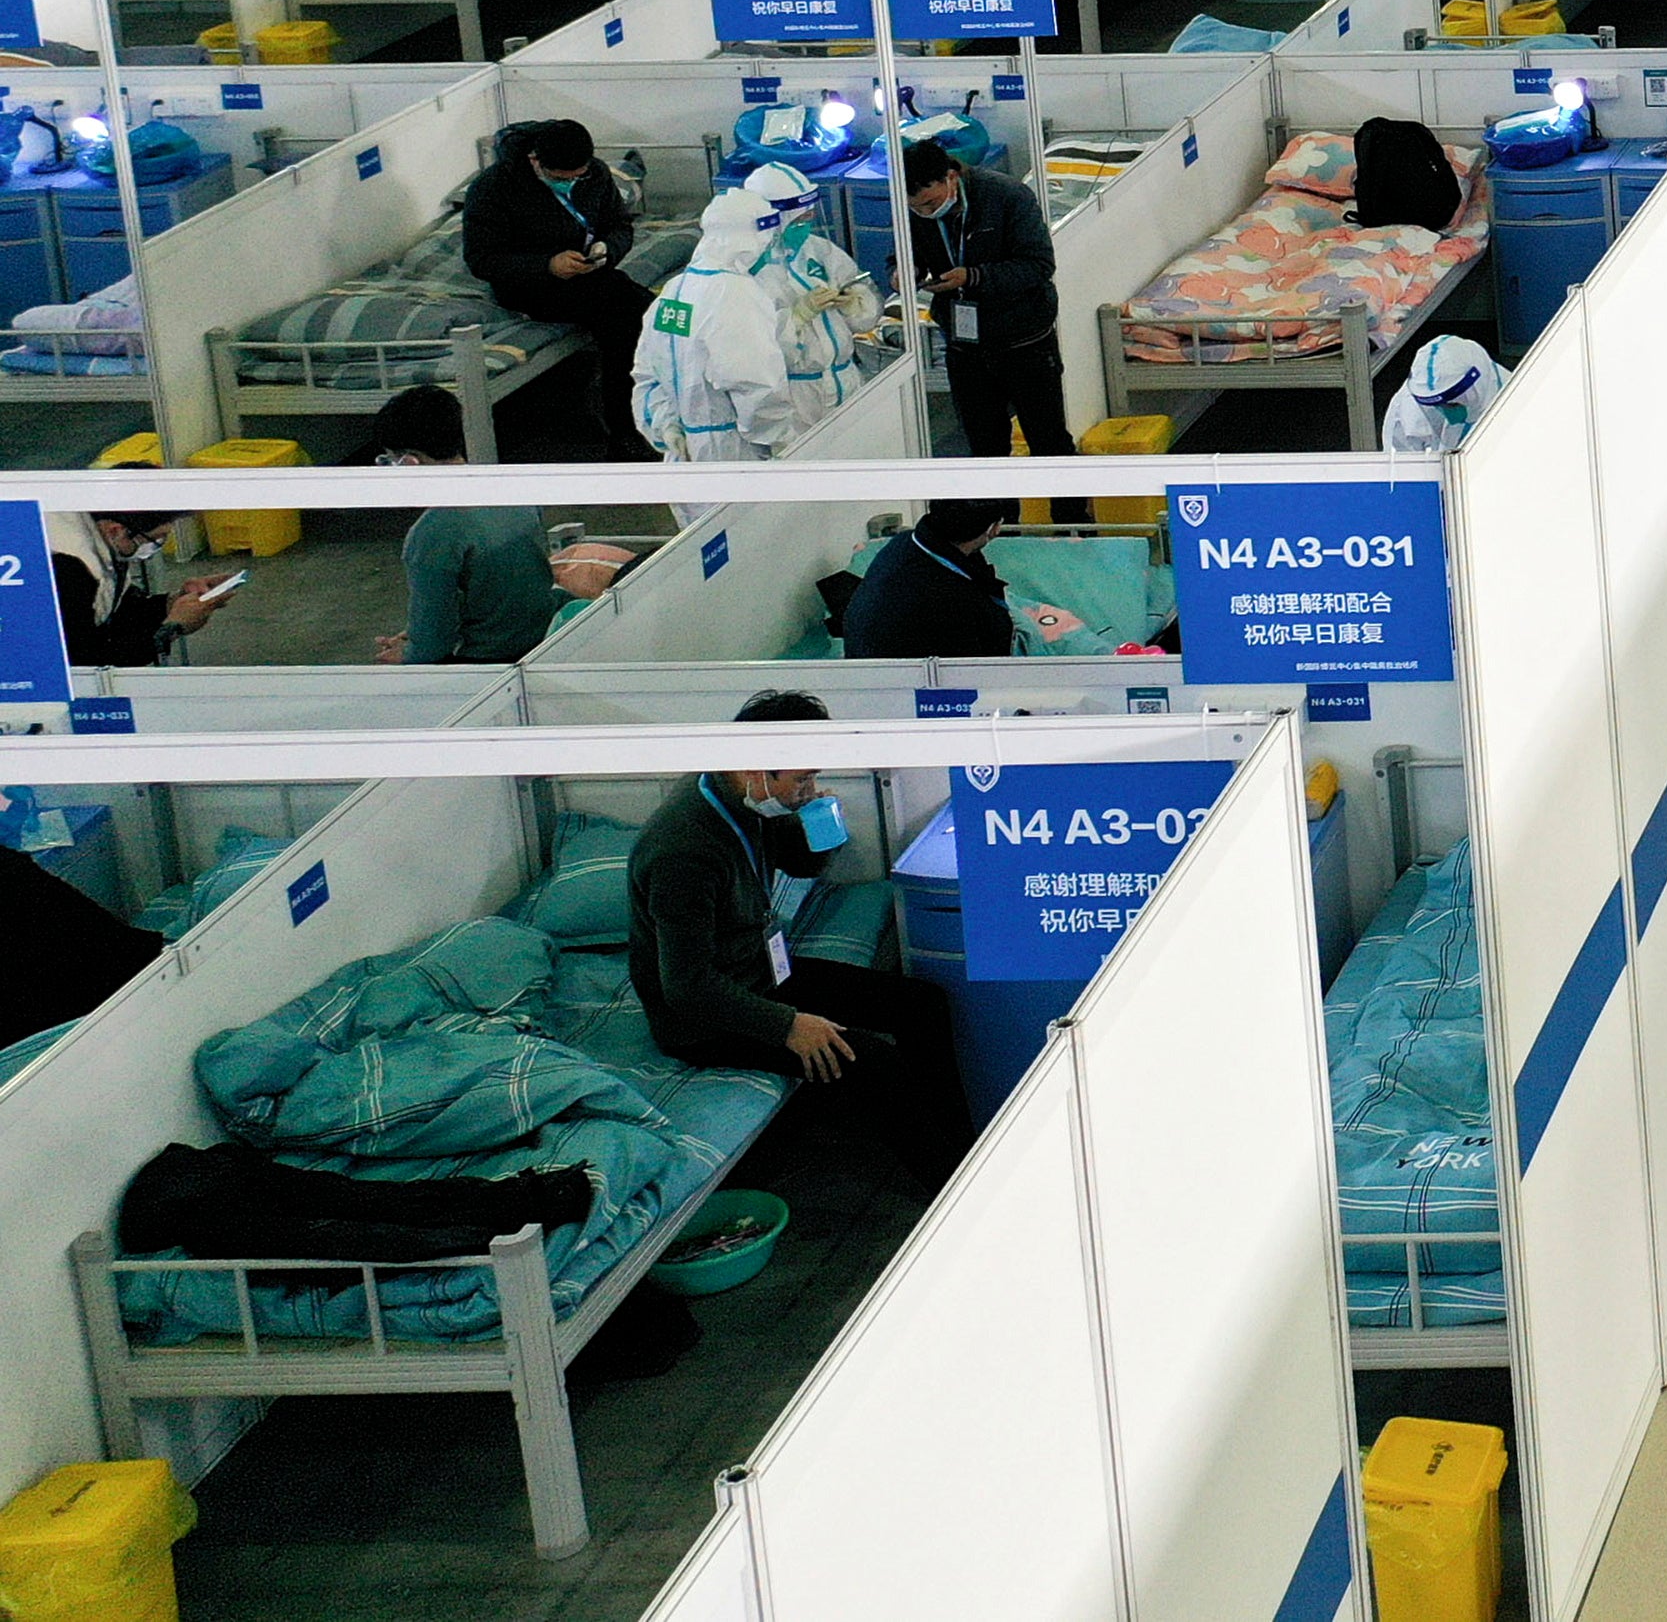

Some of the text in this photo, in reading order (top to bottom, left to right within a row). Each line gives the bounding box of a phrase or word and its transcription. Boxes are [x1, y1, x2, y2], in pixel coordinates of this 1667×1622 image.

[752, 1, 837, 15] 祝你早日康复
[1200, 536, 1413, 569] N4 A3-031
[1231, 592, 1392, 615] 感谢理解和配合
[1244, 622, 1384, 645] 祝你早日康复
[985, 808, 1208, 845] N4 A3-0
[1024, 873, 1158, 899] 感谢理解和
[1398, 1150, 1489, 1173] YORK
